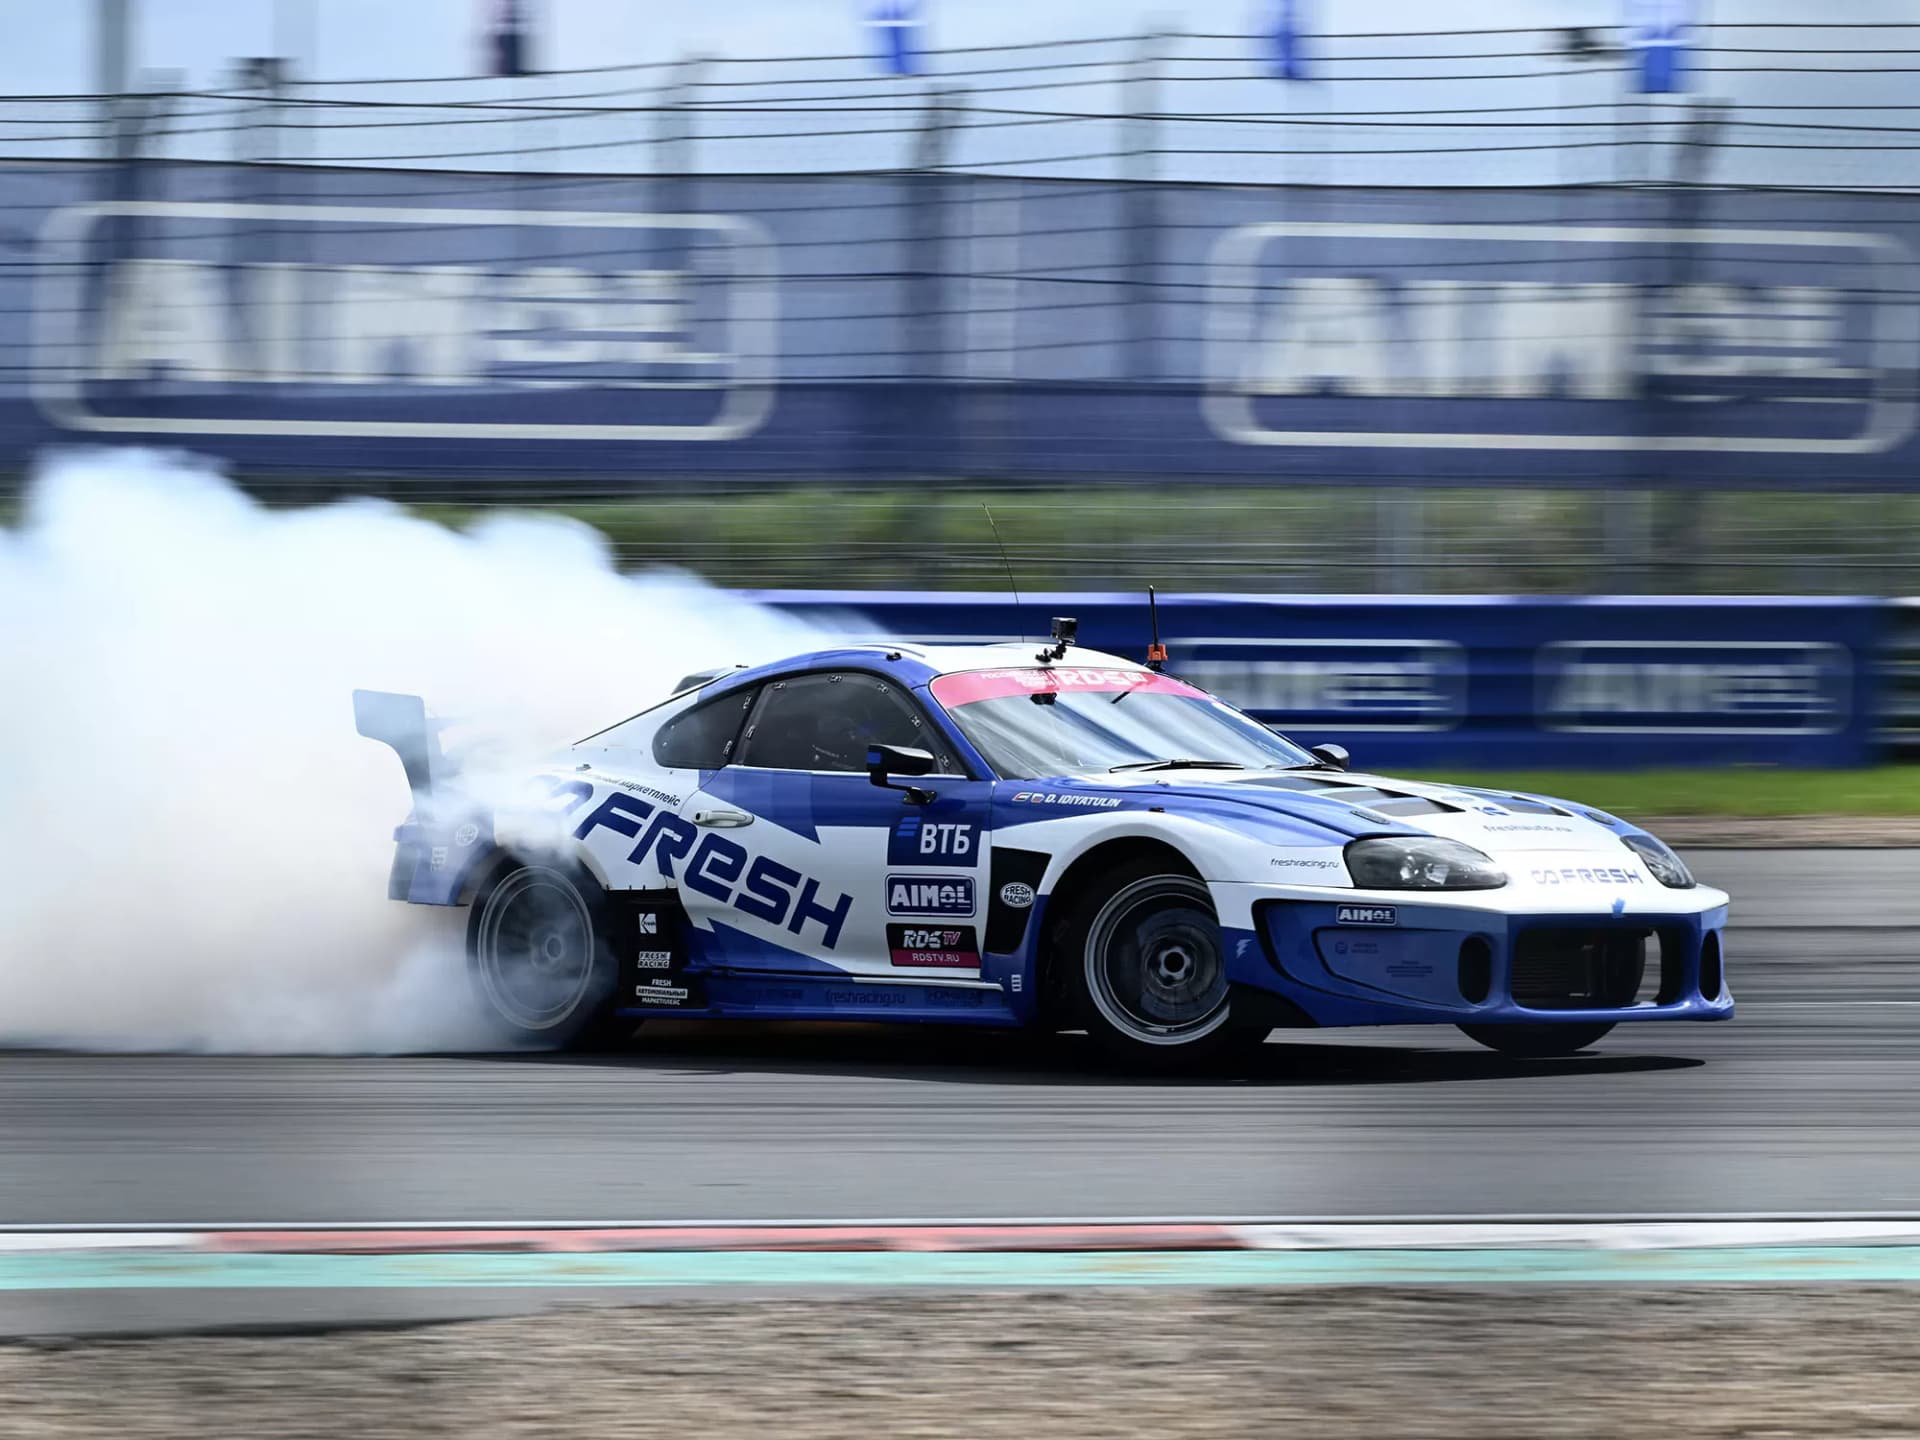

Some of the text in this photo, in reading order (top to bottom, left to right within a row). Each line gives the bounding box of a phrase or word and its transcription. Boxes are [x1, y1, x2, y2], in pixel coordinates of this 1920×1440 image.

[618, 780, 681, 807] маркетплейс
[919, 823, 972, 855] ВТБ
[1270, 857, 1340, 869] freshracing.ru
[890, 884, 972, 908] AIMOL
[1005, 885, 1031, 896] FRESH
[1004, 894, 1032, 905] RACING
[639, 951, 668, 960] FRESH
[911, 952, 961, 963] RDSTV.RU
[638, 959, 669, 968] RACING
[651, 978, 672, 987] FRESH
